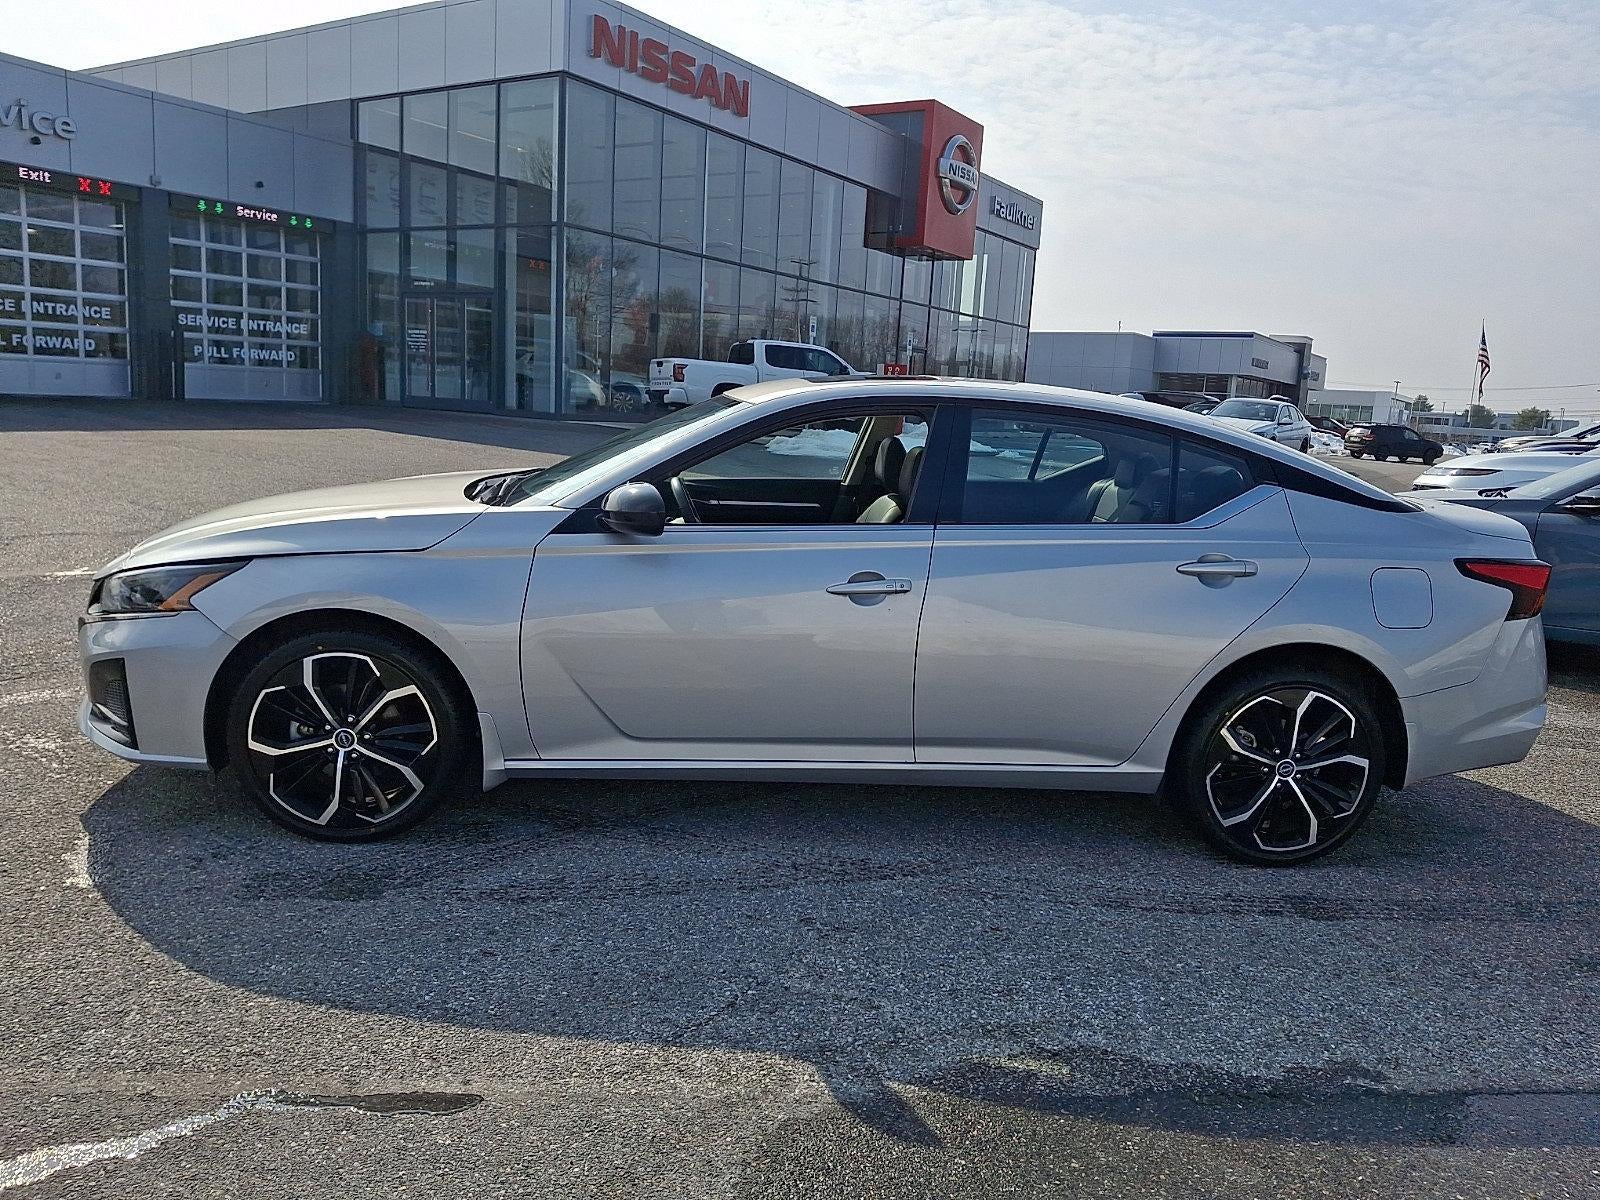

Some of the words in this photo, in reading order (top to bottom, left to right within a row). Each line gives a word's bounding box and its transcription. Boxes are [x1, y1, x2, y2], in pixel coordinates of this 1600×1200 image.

[588, 14, 750, 118] NISSAN
[18, 166, 52, 183] Exit
[948, 163, 977, 185] NISSA
[236, 205, 278, 222] Service
[991, 195, 1038, 231] Faulkner
[178, 313, 237, 329] SERVICE
[194, 345, 229, 358] PULL
